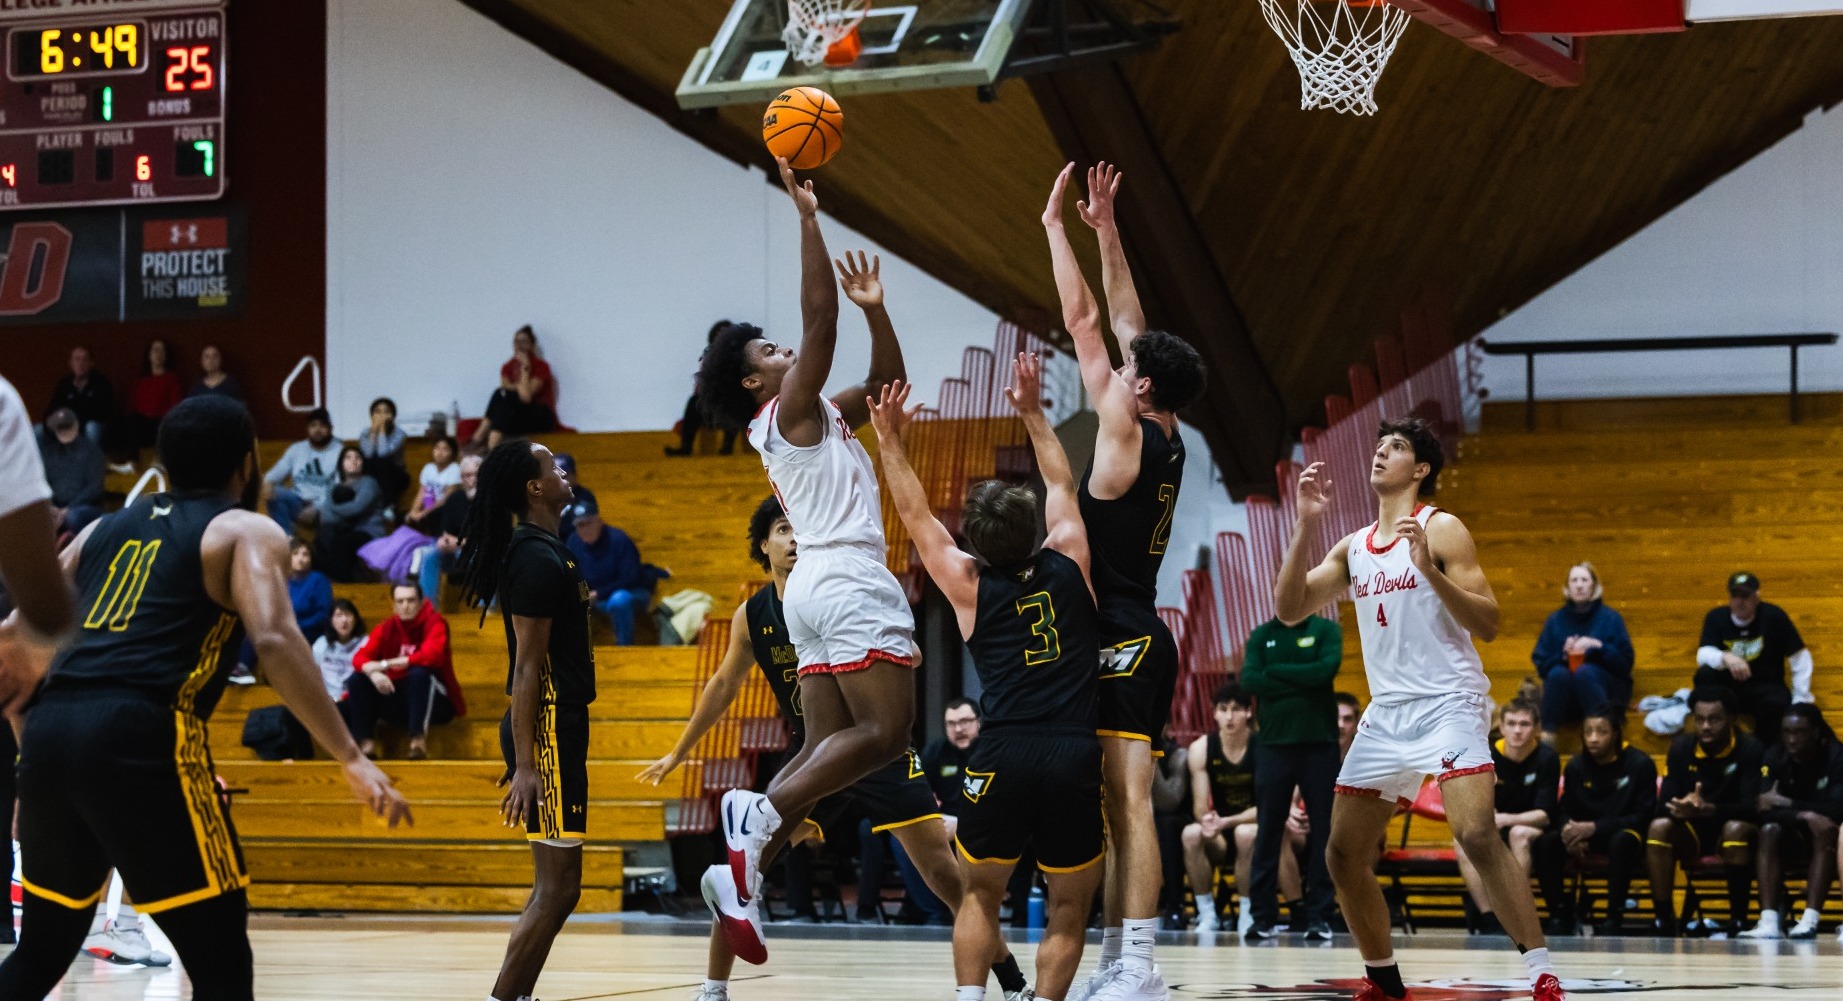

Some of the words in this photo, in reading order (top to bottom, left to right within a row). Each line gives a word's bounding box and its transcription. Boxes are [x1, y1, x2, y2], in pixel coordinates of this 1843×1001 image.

[151, 18, 219, 41] VISITOR
[41, 24, 137, 73] 6:49
[165, 45, 213, 92] 25
[41, 95, 87, 111] PERIOD
[102, 86, 112, 121] 1
[147, 98, 191, 116] BONUS
[36, 132, 83, 149] PLAYER
[95, 128, 134, 145] FOULS
[173, 124, 214, 140] FOULS
[136, 155, 150, 181] 6
[193, 141, 213, 176] 7
[1, 164, 16, 187] 4
[131, 182, 155, 198] TOL
[142, 249, 228, 276] PROTECT
[142, 279, 175, 299] THIS
[1149, 484, 1175, 554] 2
[83, 539, 163, 632] 11
[1351, 574, 1371, 599] Red
[1373, 567, 1419, 595] Devils
[1376, 602, 1388, 628] 4
[1016, 591, 1061, 666] 3
